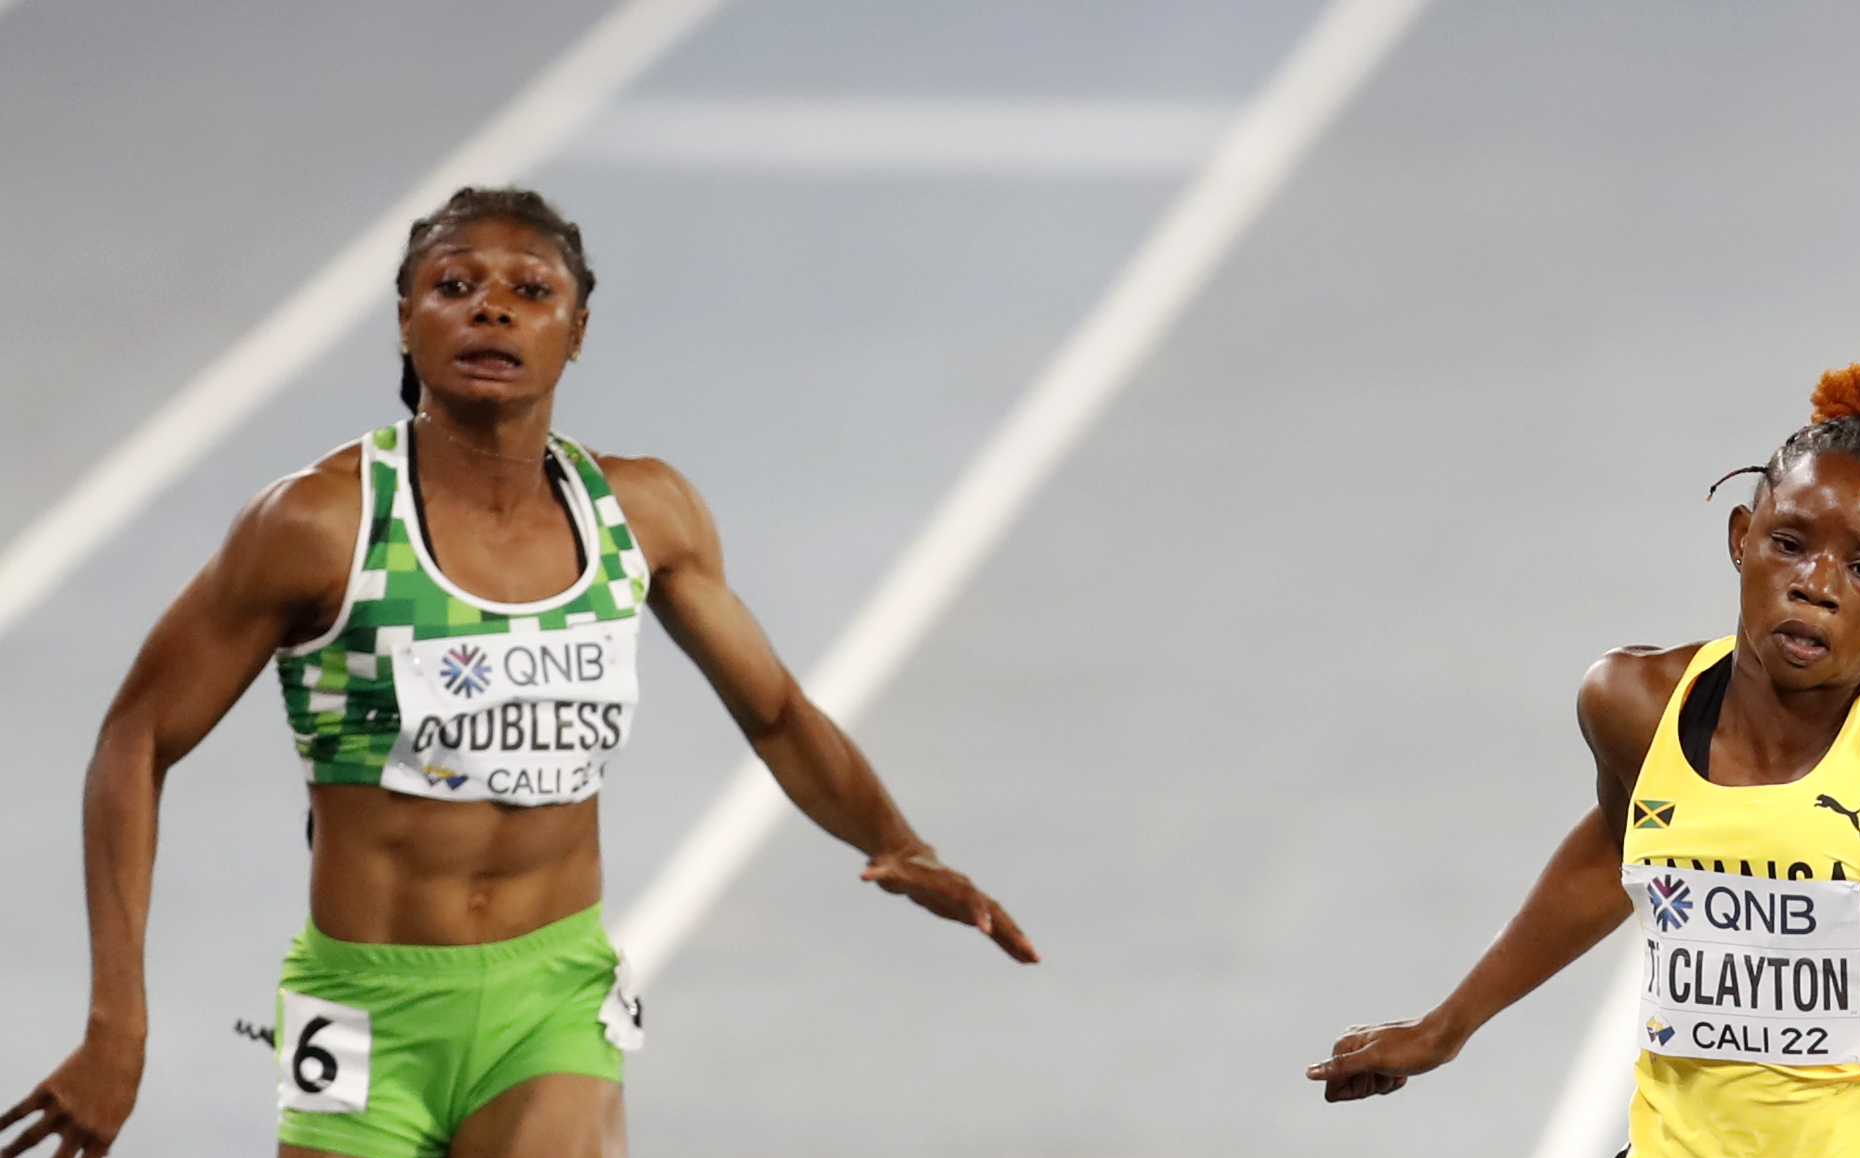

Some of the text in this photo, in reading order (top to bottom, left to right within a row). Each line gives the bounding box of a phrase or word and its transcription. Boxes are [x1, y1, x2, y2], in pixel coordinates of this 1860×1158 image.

[503, 642, 604, 686] QNB
[487, 768, 562, 795] CALI
[1704, 886, 1817, 936] QNB
[1668, 947, 1849, 1013] CLAYTON
[292, 1015, 338, 1094] 6
[1692, 1021, 1830, 1056] CALI 22
